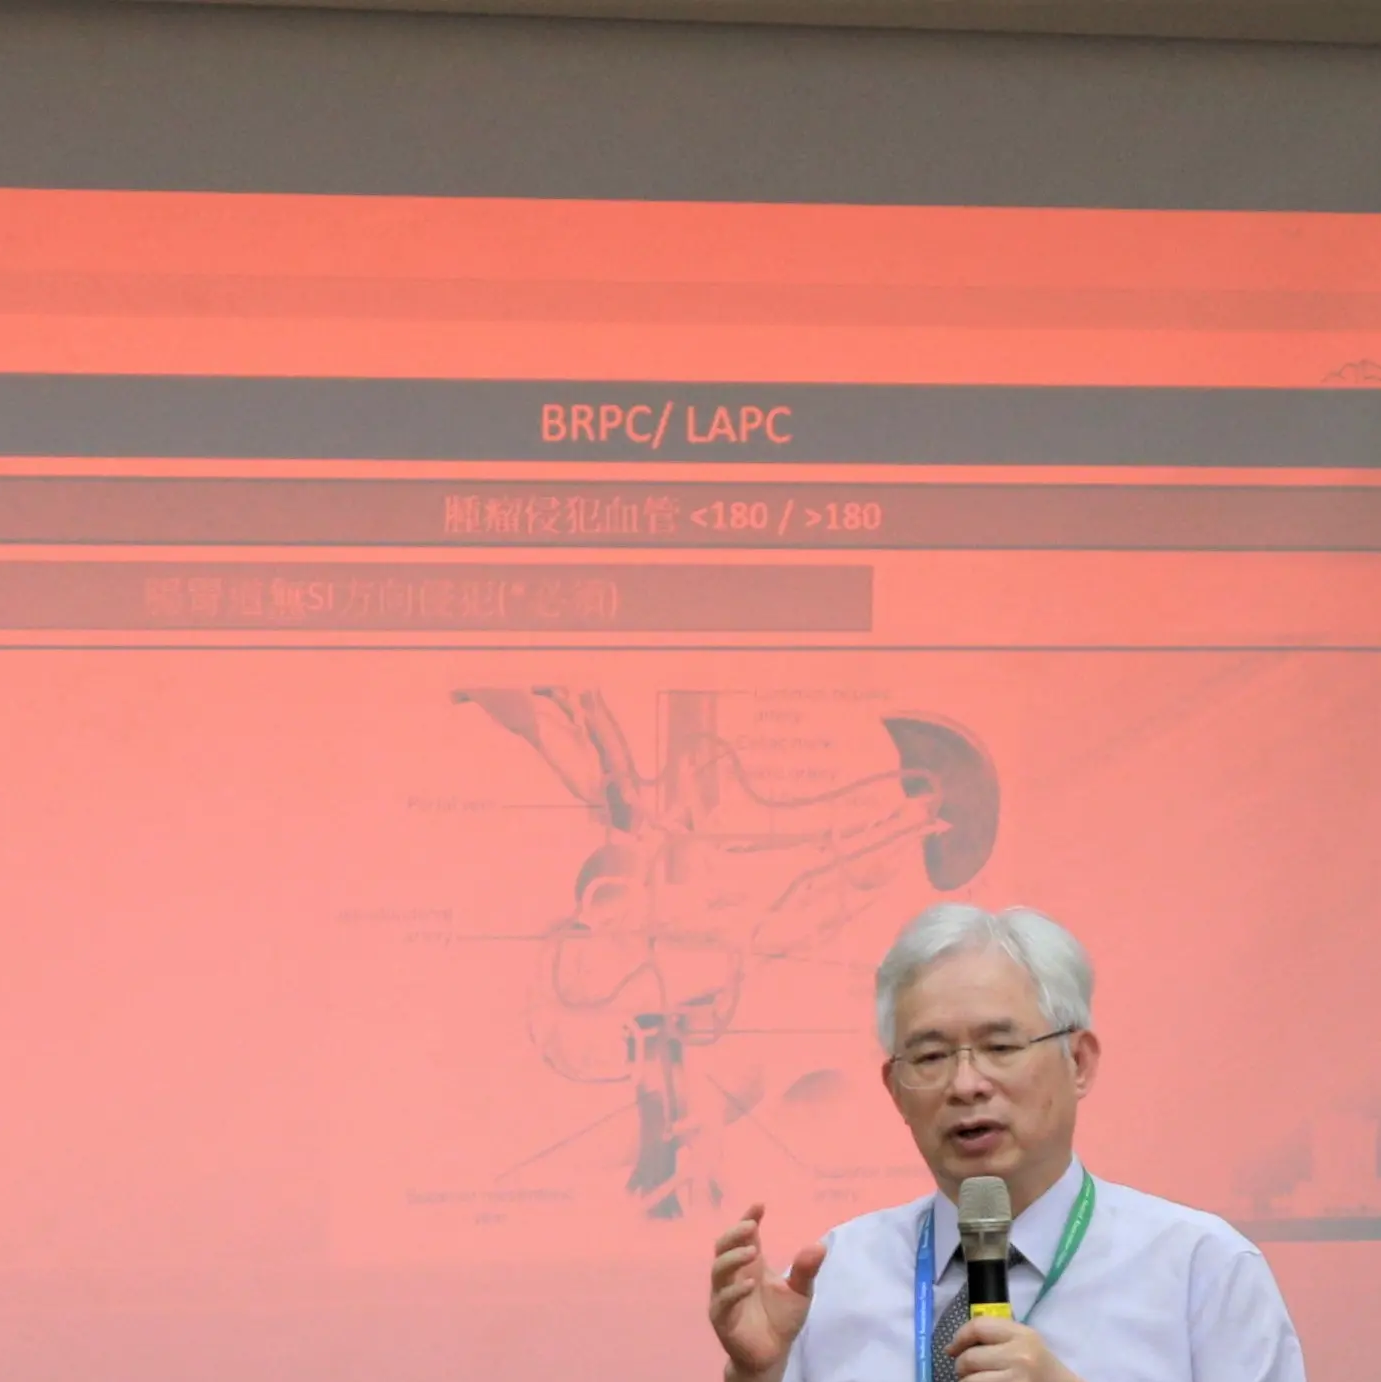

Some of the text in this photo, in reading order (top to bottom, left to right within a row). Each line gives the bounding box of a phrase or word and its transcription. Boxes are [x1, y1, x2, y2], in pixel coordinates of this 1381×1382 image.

[541, 400, 793, 450] BRPC/ LAPC
[443, 495, 680, 535] 腫瘤侵犯血管
[690, 502, 768, 530] <180
[804, 502, 882, 530] >180
